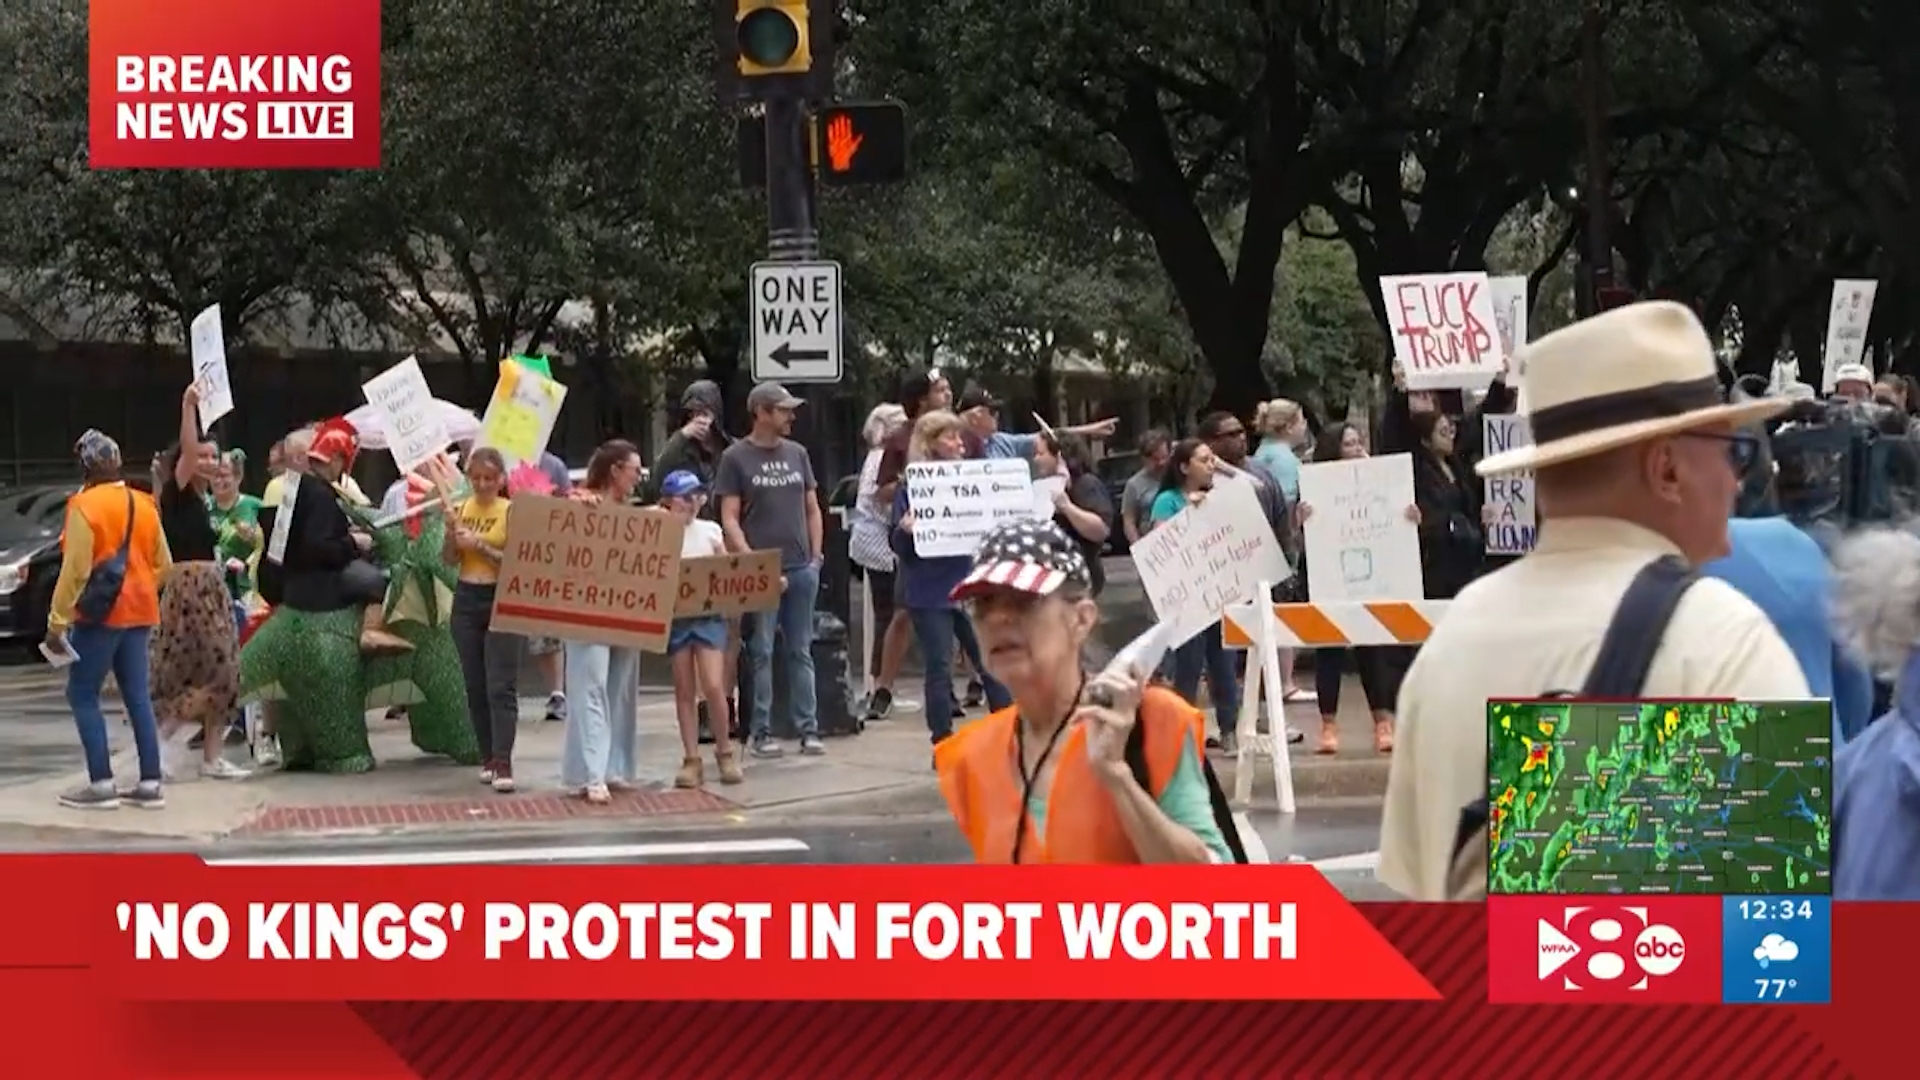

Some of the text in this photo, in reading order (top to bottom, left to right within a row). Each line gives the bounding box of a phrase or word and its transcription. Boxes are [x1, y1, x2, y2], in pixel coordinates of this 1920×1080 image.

[762, 276, 829, 303] ONE
[1397, 281, 1485, 333] FUCK
[762, 307, 830, 335] WAY
[1397, 325, 1492, 369] TRUMP
[908, 466, 934, 480] PAY
[911, 485, 936, 499] PAY
[951, 485, 981, 498] TSA
[1491, 480, 1525, 506] FOR
[914, 507, 935, 520] NO
[1502, 502, 1517, 521] A
[550, 509, 662, 545] FASCISM
[916, 529, 937, 542] NO
[1487, 522, 1536, 552] CLOWN
[517, 541, 555, 565] HAS
[565, 548, 594, 571] NO
[606, 550, 672, 580] PLACE
[680, 571, 769, 599] O KINGS
